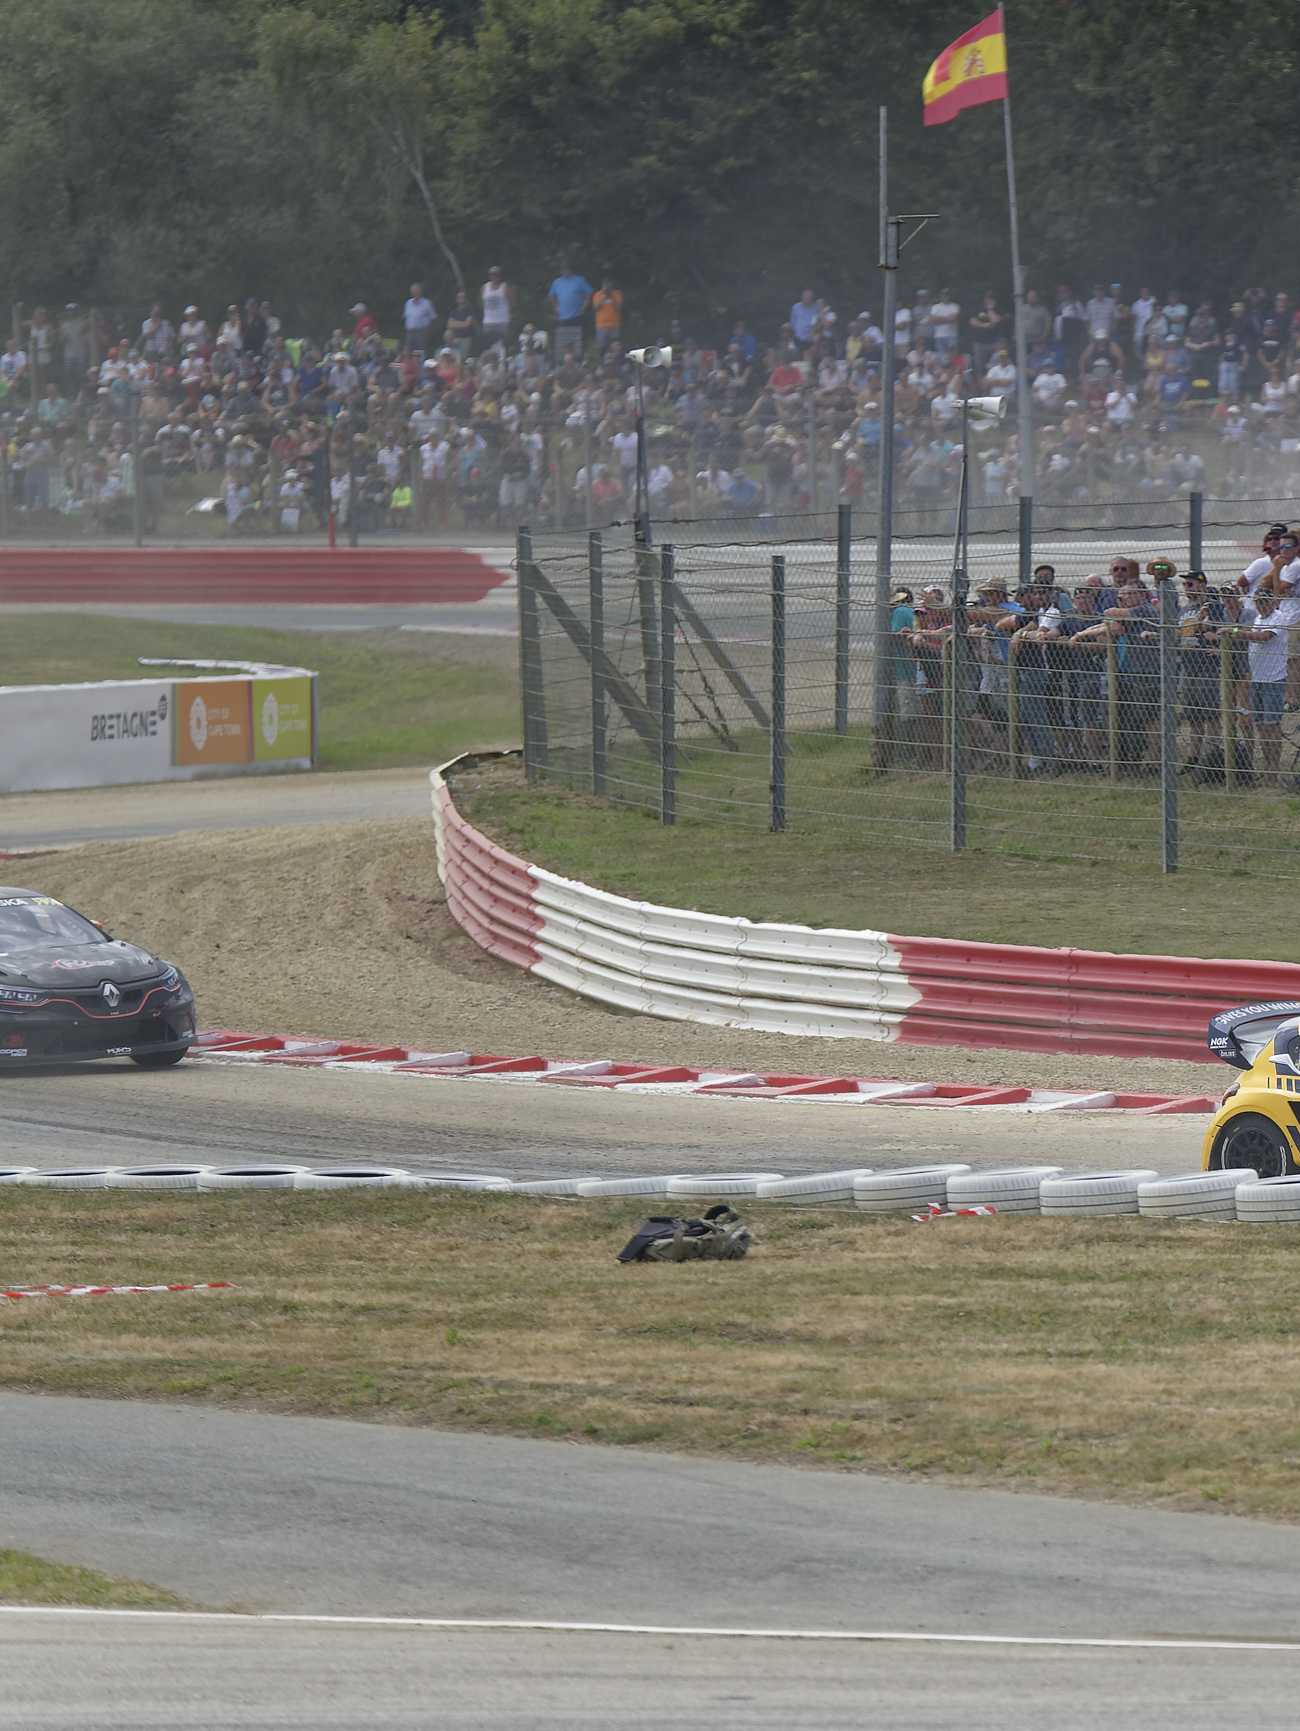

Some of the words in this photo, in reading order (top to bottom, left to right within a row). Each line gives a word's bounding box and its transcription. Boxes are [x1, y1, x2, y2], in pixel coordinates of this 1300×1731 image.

[91, 710, 157, 741] BRETAGNE
[1215, 1009, 1247, 1025] GIVES
[1241, 1003, 1271, 1015] YOU
[1210, 1037, 1229, 1046] NGK
